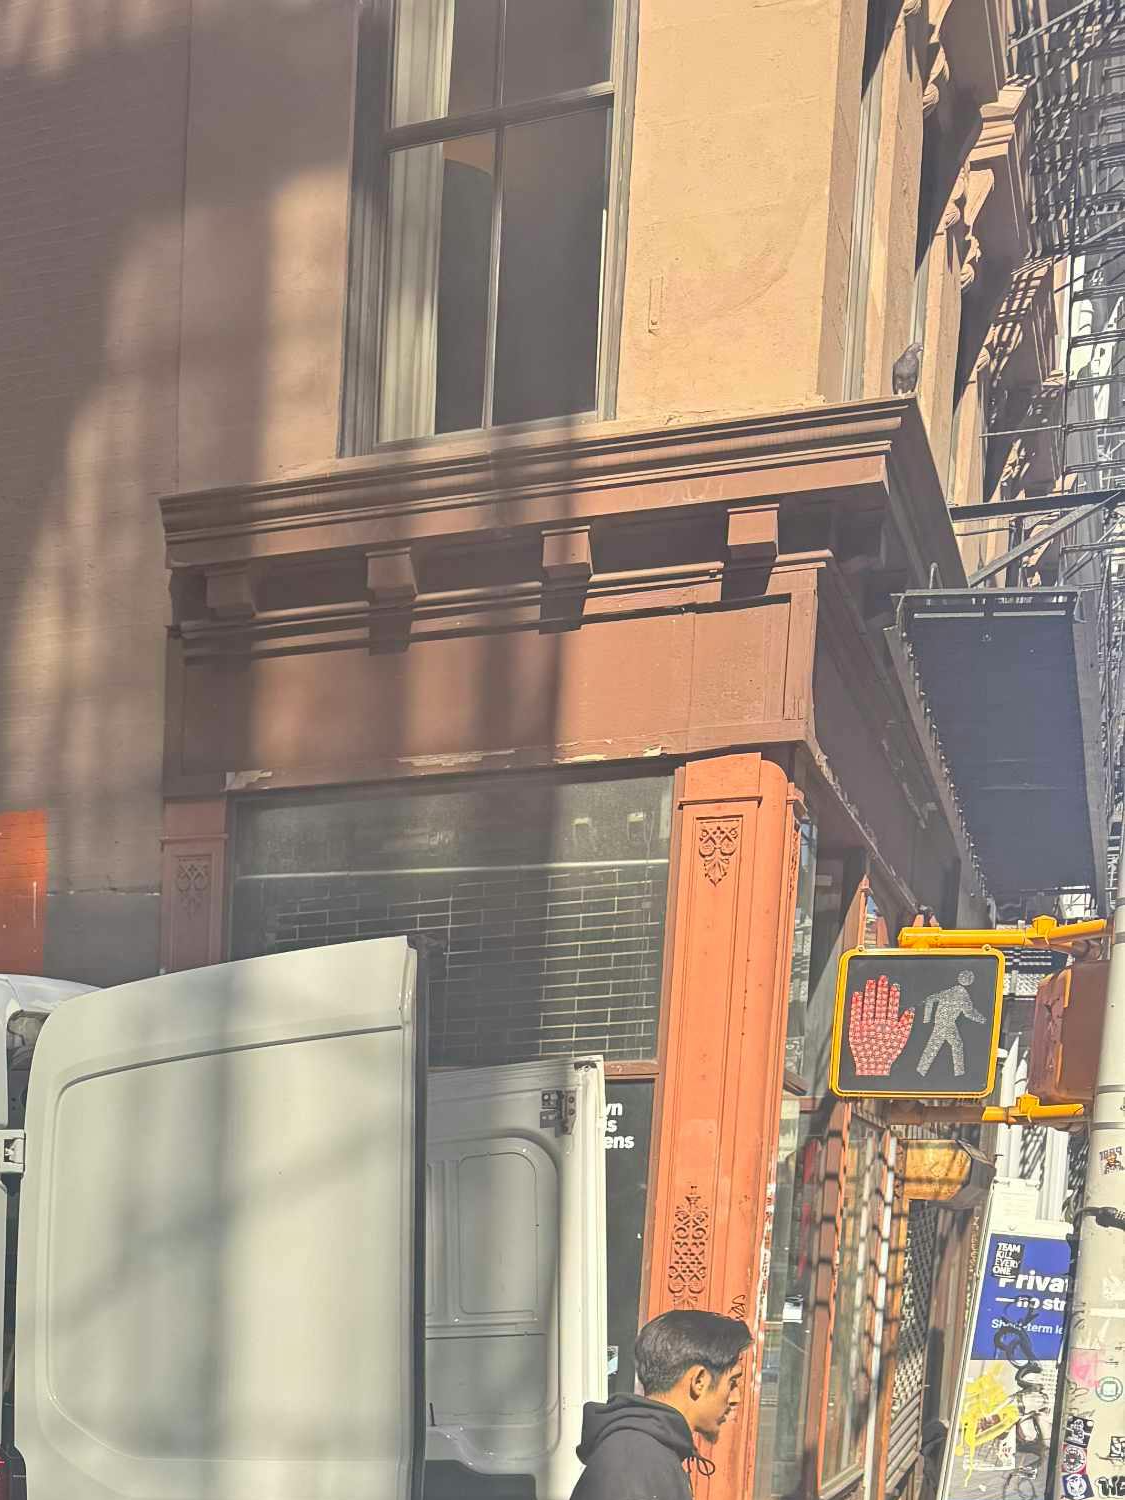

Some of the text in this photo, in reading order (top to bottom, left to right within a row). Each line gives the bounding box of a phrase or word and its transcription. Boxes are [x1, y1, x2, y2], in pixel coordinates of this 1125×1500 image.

[997, 1242, 1021, 1253] TEAM
[994, 1258, 1021, 1269] EVERY
[992, 1265, 1013, 1275] ONE
